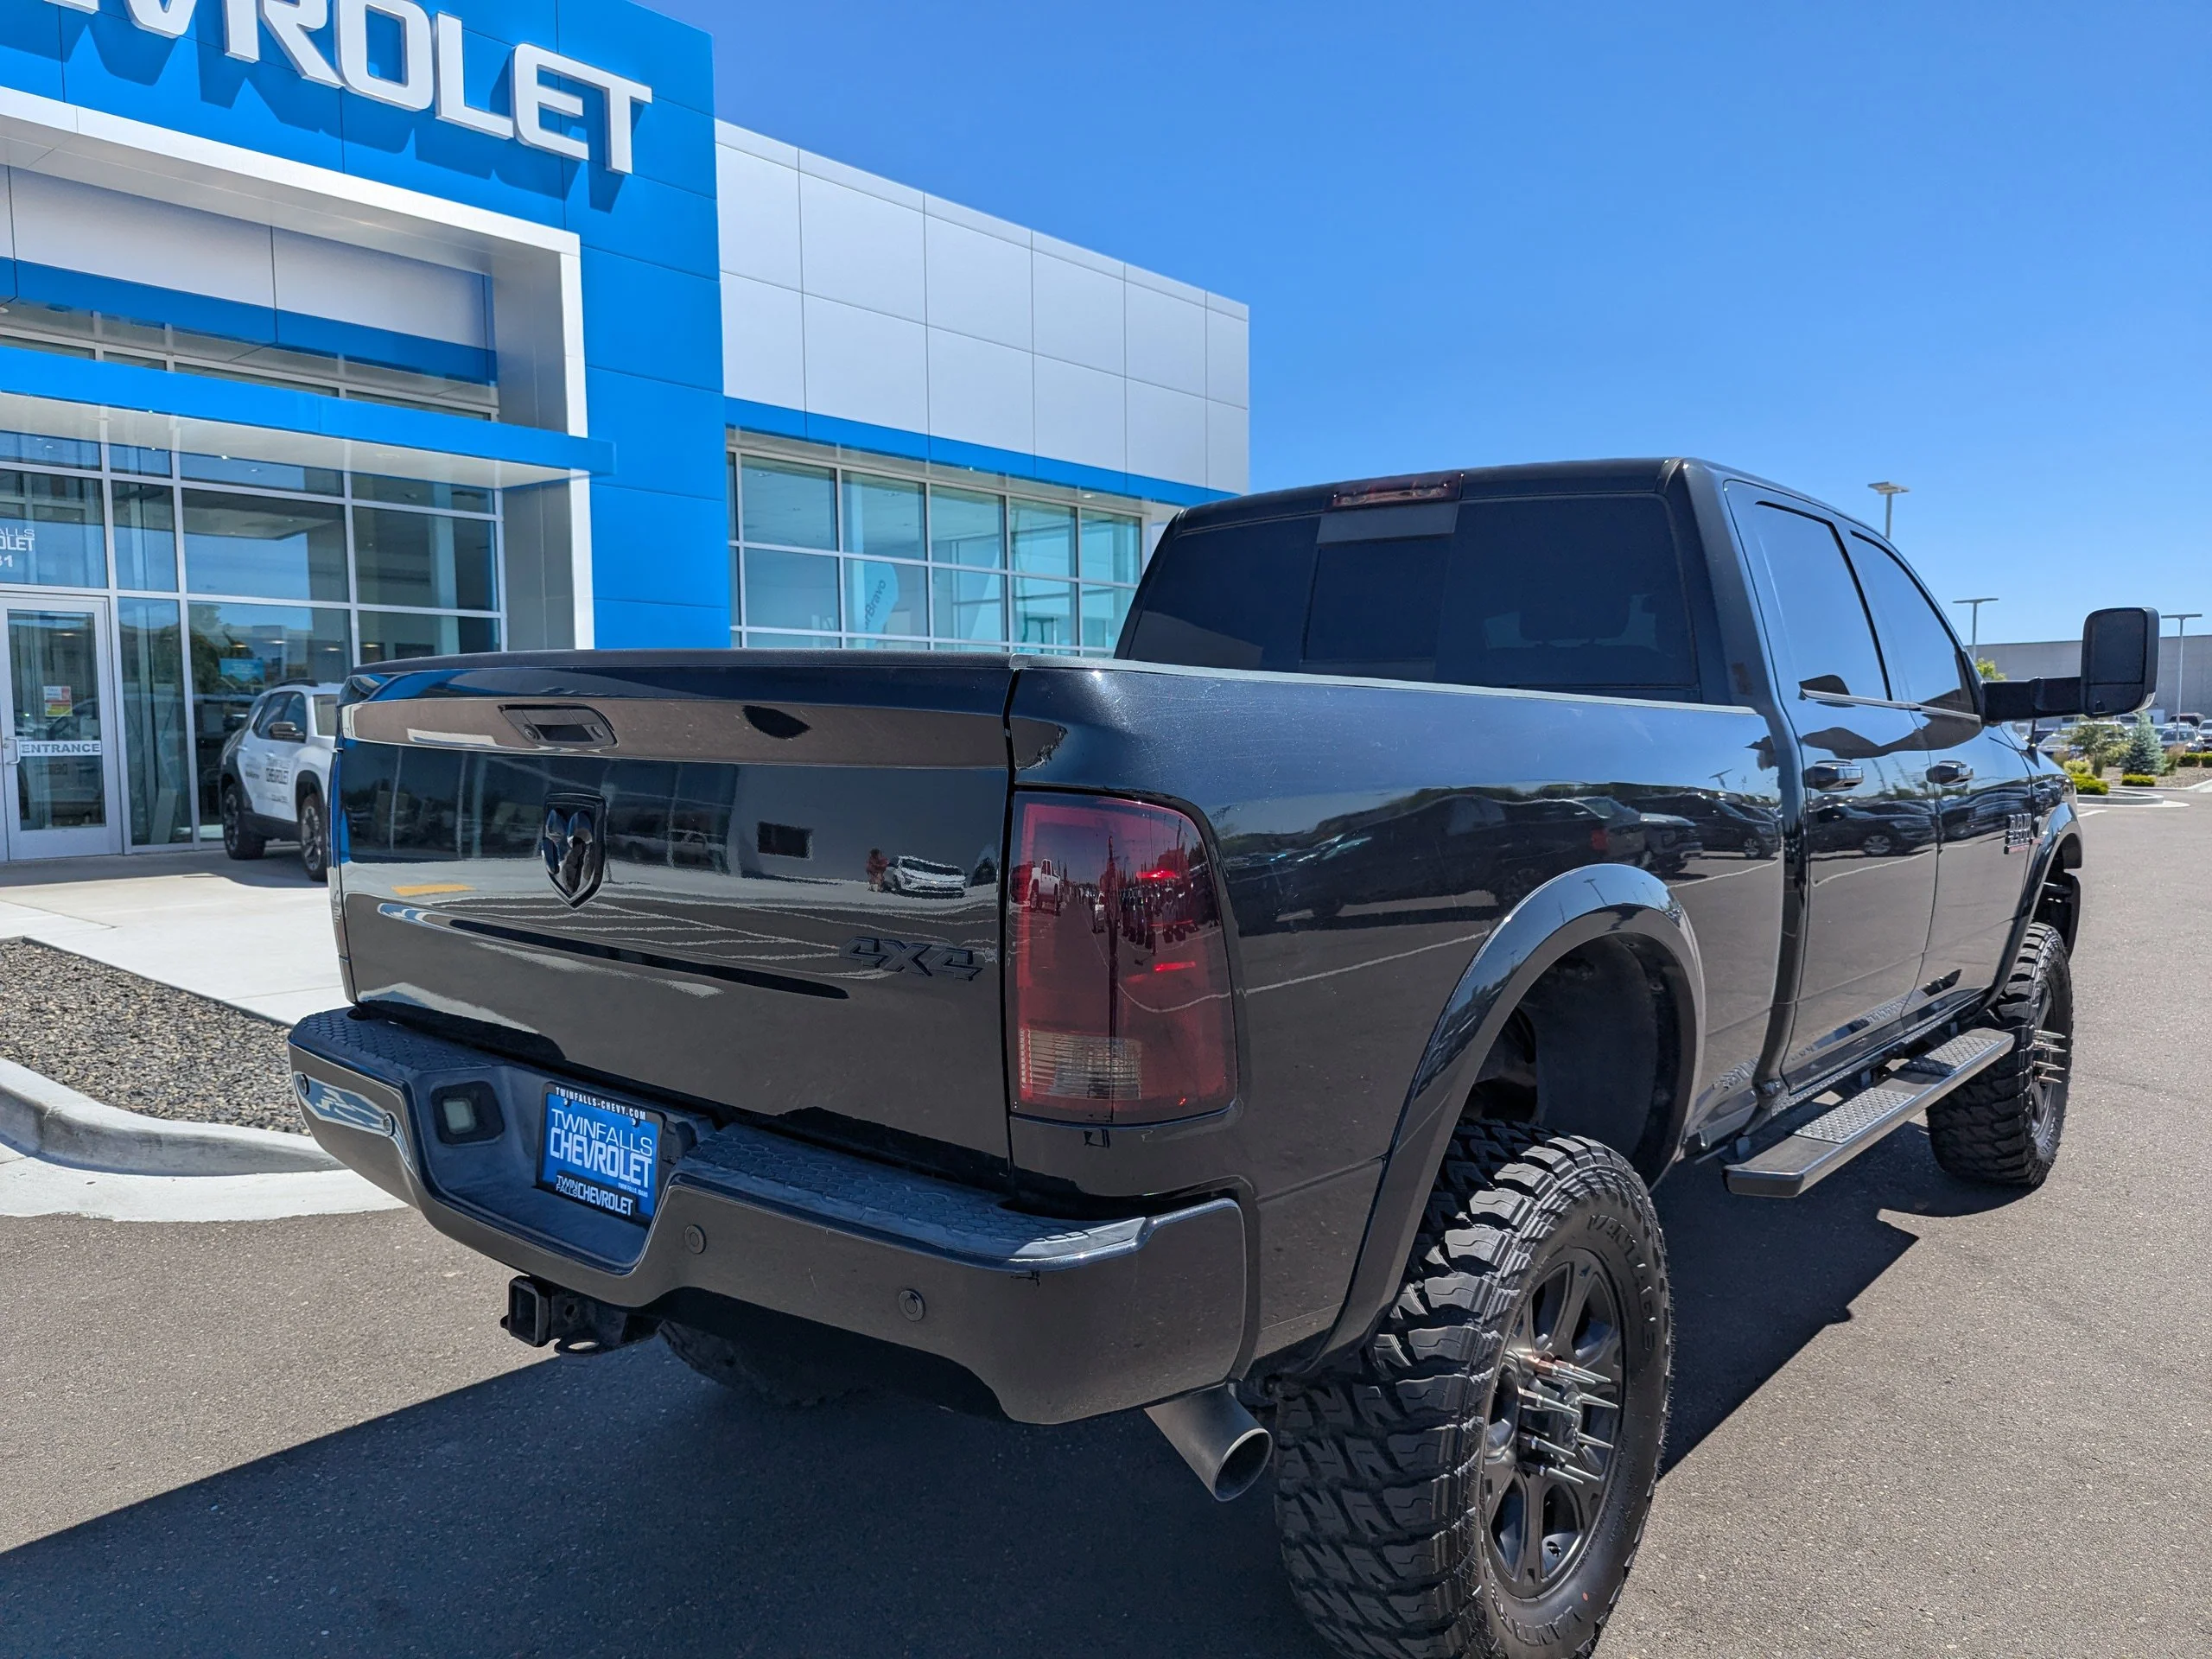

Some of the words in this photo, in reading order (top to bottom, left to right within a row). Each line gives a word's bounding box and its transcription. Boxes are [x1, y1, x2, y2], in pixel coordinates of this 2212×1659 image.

[21, 743, 101, 754] ENTRANCE
[2008, 813, 2031, 830] RAM
[555, 1086, 647, 1121] TWINFALLS-CHEVY.COM
[550, 1127, 652, 1189] CHEVROLET
[555, 1183, 578, 1198] FALLS
[556, 1174, 579, 1190] TWIN
[577, 1182, 633, 1217] CHEVROLET
